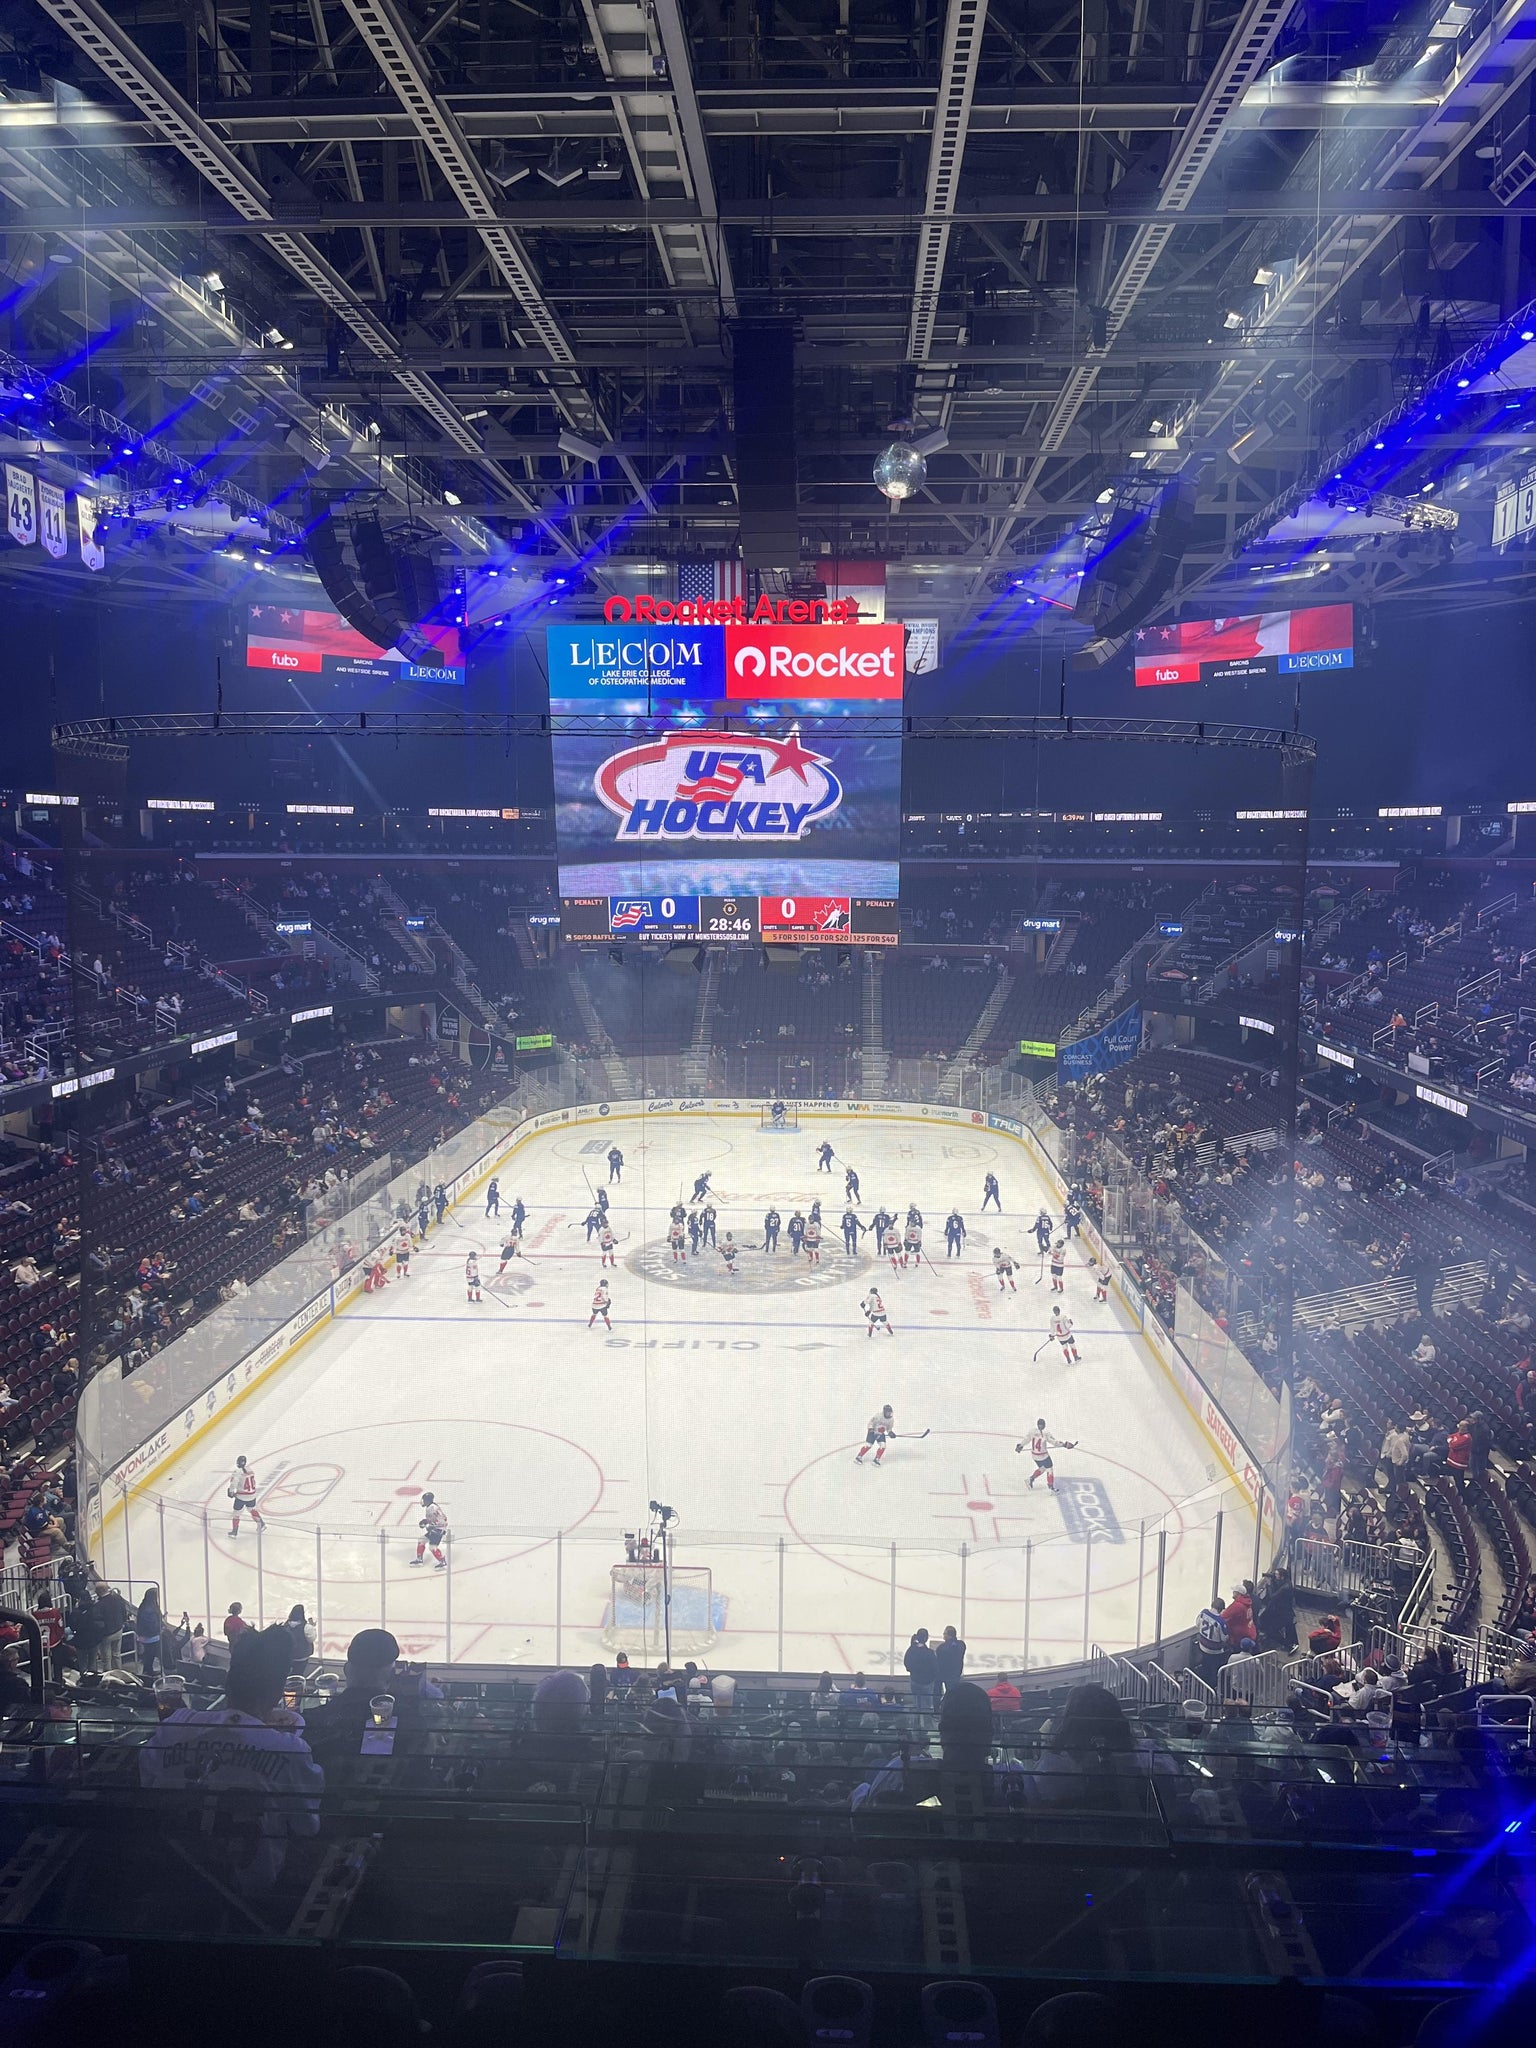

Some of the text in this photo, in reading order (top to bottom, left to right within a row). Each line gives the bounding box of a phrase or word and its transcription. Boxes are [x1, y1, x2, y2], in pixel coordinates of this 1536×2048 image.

[12, 471, 27, 483] BRAD
[11, 493, 32, 531] 43
[46, 508, 62, 543] 11
[1502, 502, 1508, 538] 1
[636, 594, 849, 623] Rocket Arena
[272, 653, 299, 666] fubo
[570, 640, 702, 668] LECOM
[1289, 653, 1343, 669] LECOM
[770, 646, 895, 677] Rocket
[409, 666, 457, 680] LECOM
[1155, 669, 1179, 681] fubo
[680, 751, 766, 796] USA
[625, 800, 812, 834] HOCKEY
[661, 898, 676, 918] 0
[781, 899, 796, 918] 0
[276, 922, 312, 933] drug mart
[530, 916, 547, 925] drug
[709, 918, 751, 932] 28:46
[1023, 919, 1060, 929] drug mart
[1275, 931, 1291, 941] drug
[1104, 1035, 1137, 1044] Full Court
[1109, 1044, 1132, 1052] Power
[992, 1118, 1021, 1134] TRUE
[770, 1216, 779, 1226] 27
[793, 1222, 801, 1231] 31
[953, 1221, 958, 1229] 6
[298, 1303, 319, 1329] CENTER
[320, 1294, 329, 1312] ICE
[1056, 1323, 1062, 1334] 4
[605, 1338, 761, 1351] CLIFFS
[1206, 1403, 1237, 1467] SEATGEEK
[1032, 1437, 1042, 1452] 14
[114, 1432, 167, 1485] AVONLAKE
